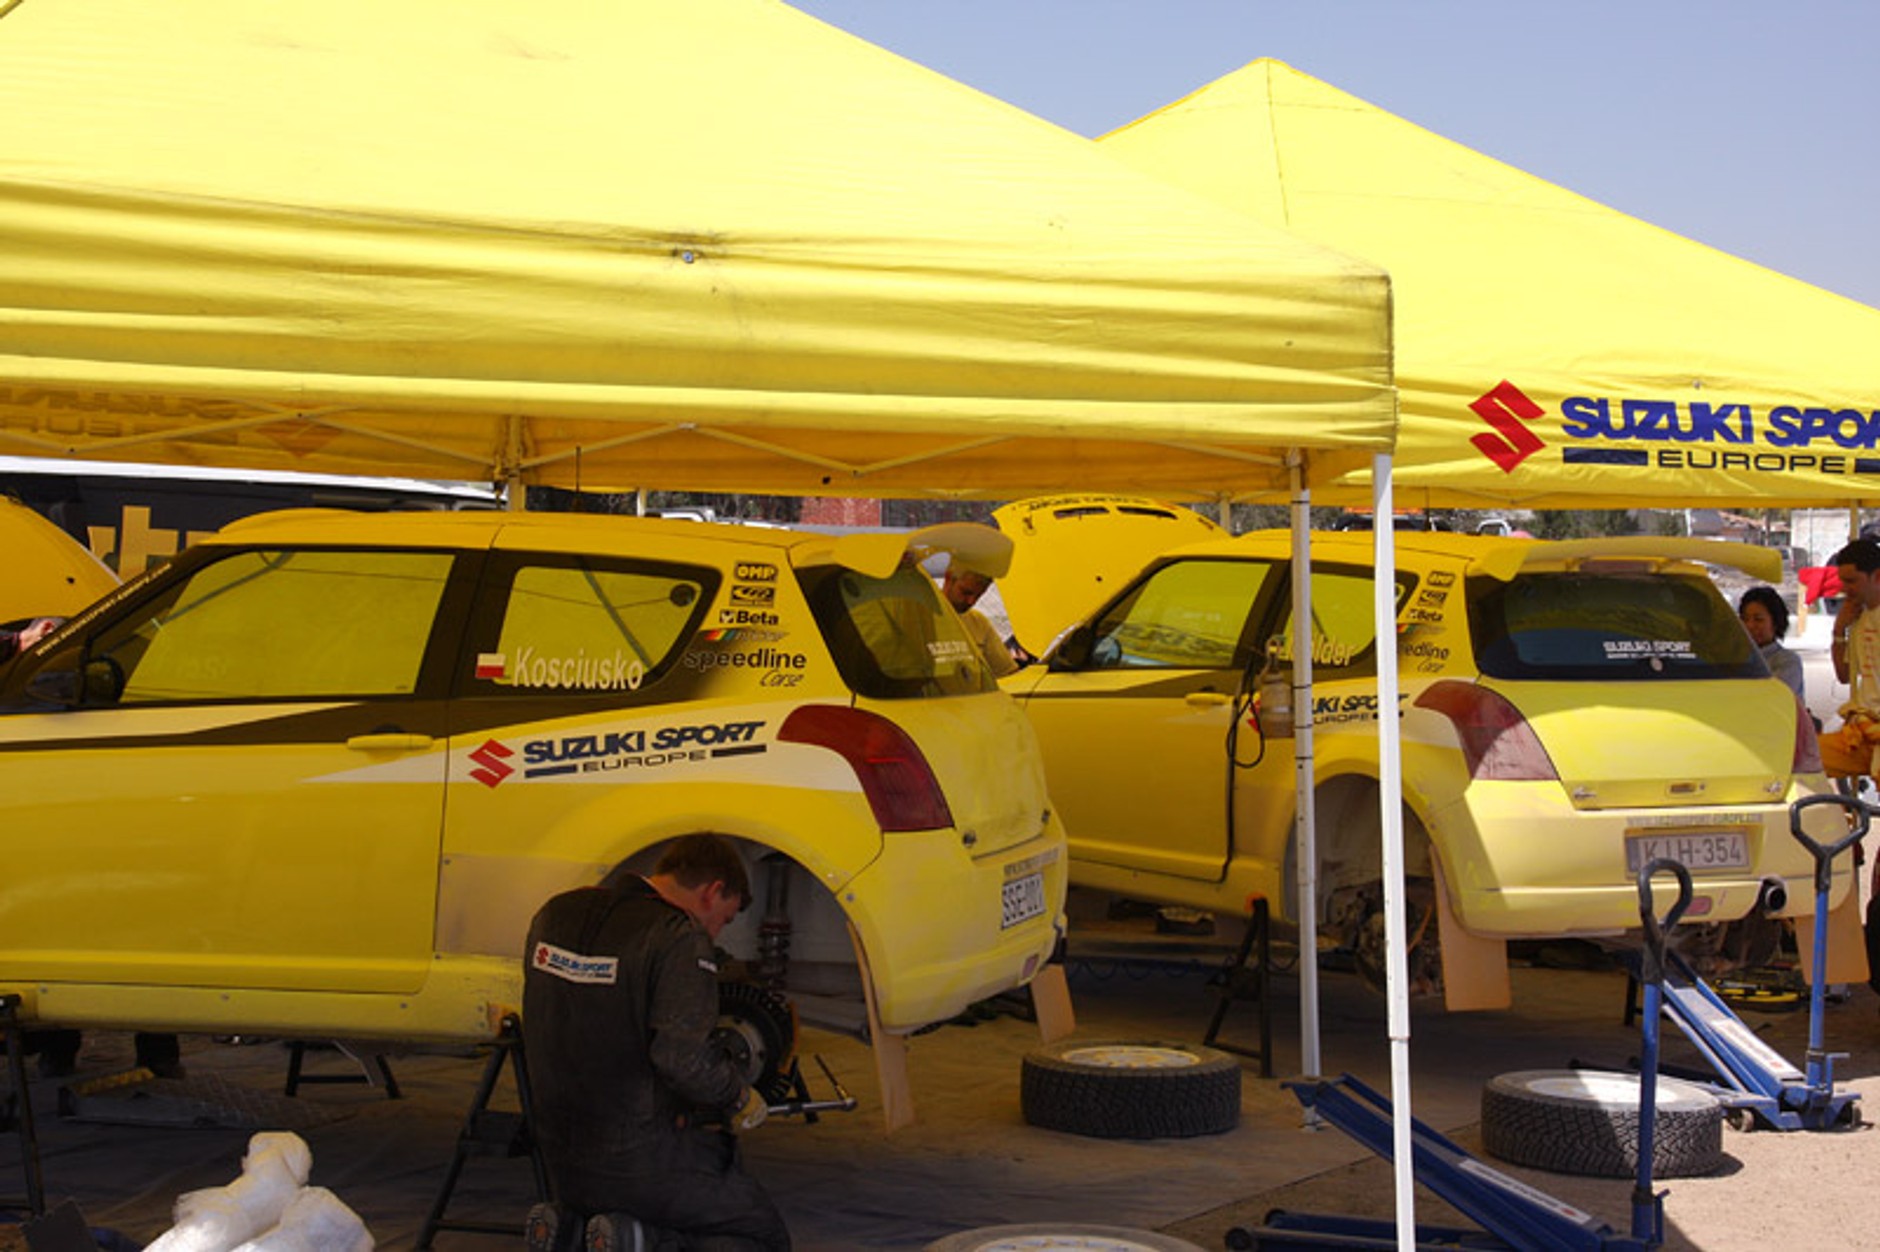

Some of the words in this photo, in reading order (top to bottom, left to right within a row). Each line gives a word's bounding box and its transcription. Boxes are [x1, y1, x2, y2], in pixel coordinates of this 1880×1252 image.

[1560, 397, 1754, 444] SUZUKI
[1658, 449, 1846, 474] EUROPE
[736, 610, 779, 625] Beta
[512, 646, 643, 691] Kosciusko
[1313, 713, 1369, 725] UROPE
[523, 731, 645, 764] SUZUKI
[652, 721, 766, 749] SPORT
[583, 750, 707, 772] EUROPE
[1643, 836, 1742, 864] KIH-354
